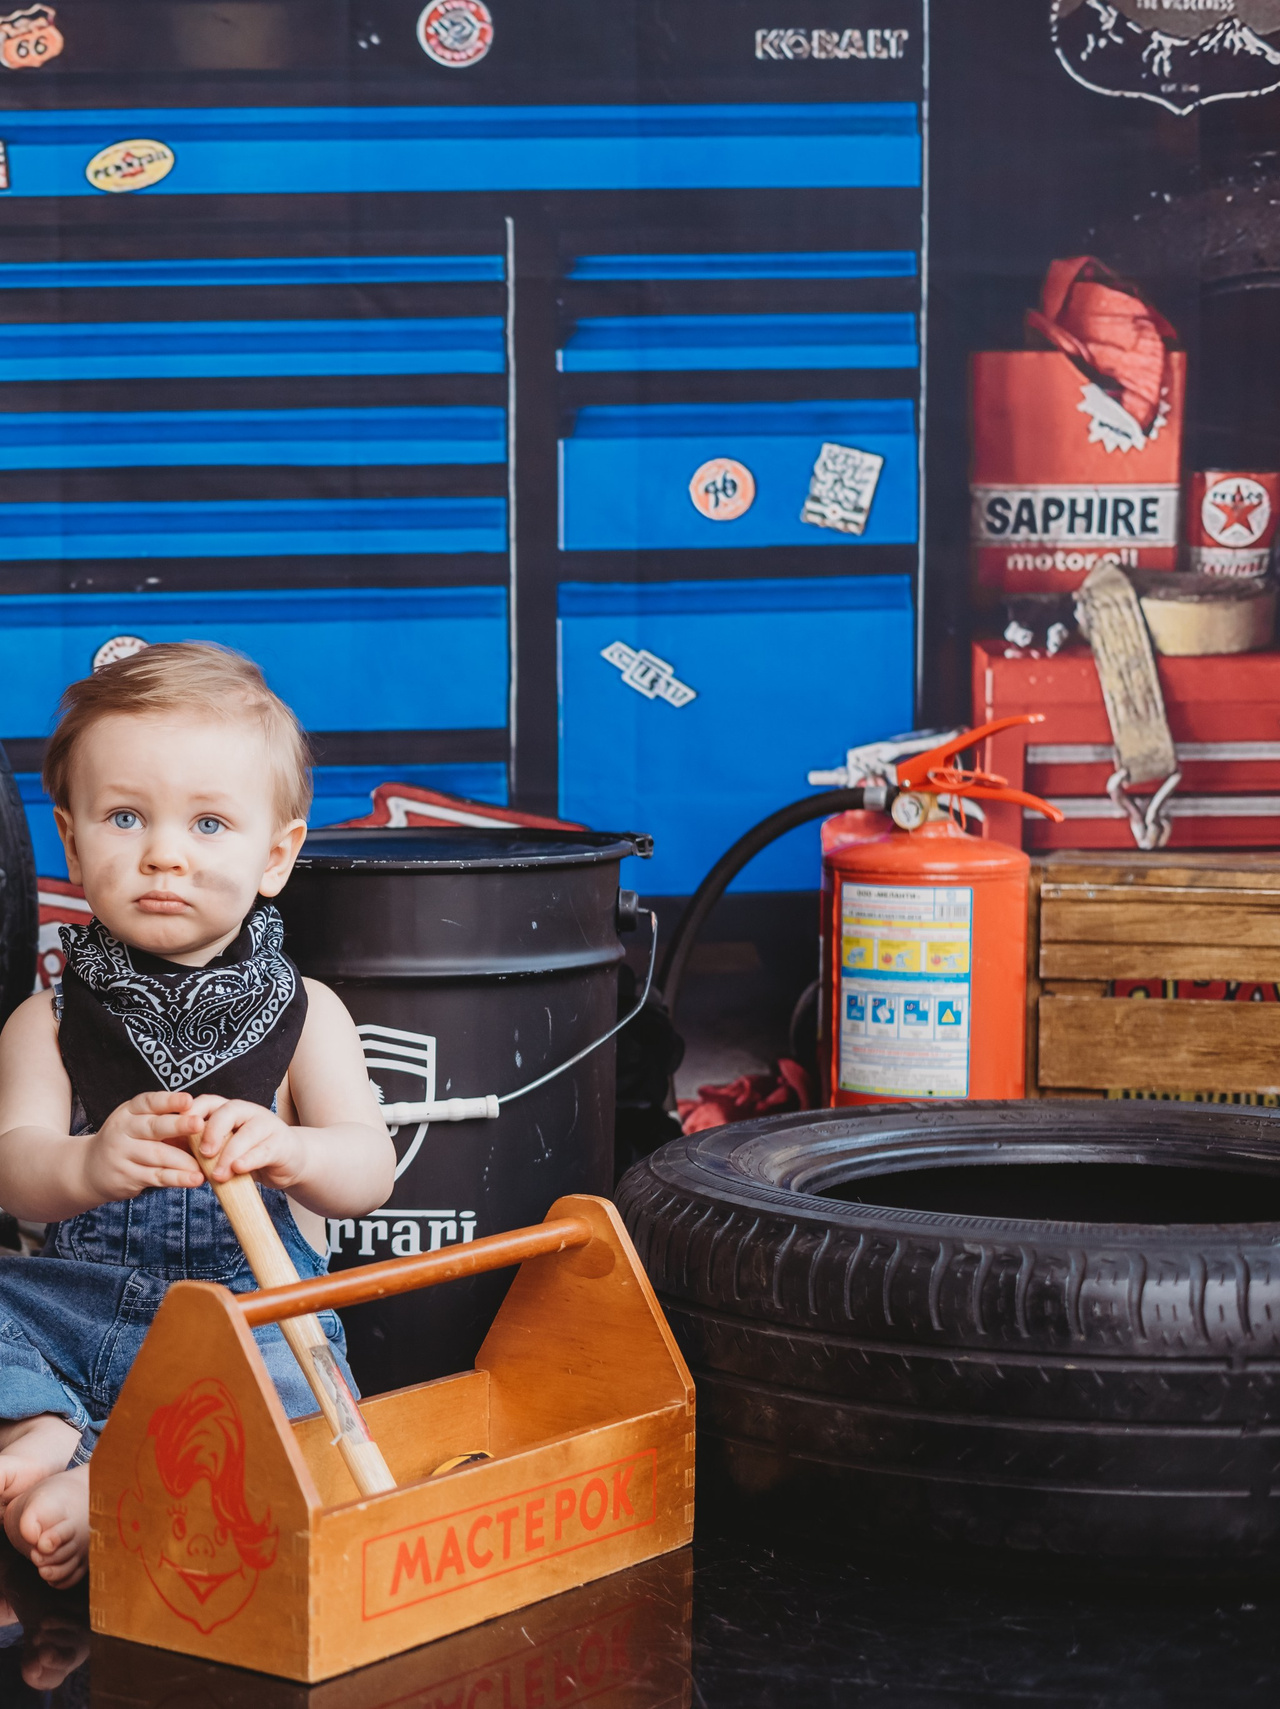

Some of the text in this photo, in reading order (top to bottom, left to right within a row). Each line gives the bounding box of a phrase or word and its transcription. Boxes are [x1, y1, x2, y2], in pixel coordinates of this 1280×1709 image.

[16, 35, 48, 59] 66
[754, 28, 910, 60] KOBALT
[985, 496, 1160, 536] SAPHIRE
[1006, 550, 1098, 572] motor
[326, 1210, 478, 1257] rrari
[389, 1465, 636, 1597] МАСТЕРОК
